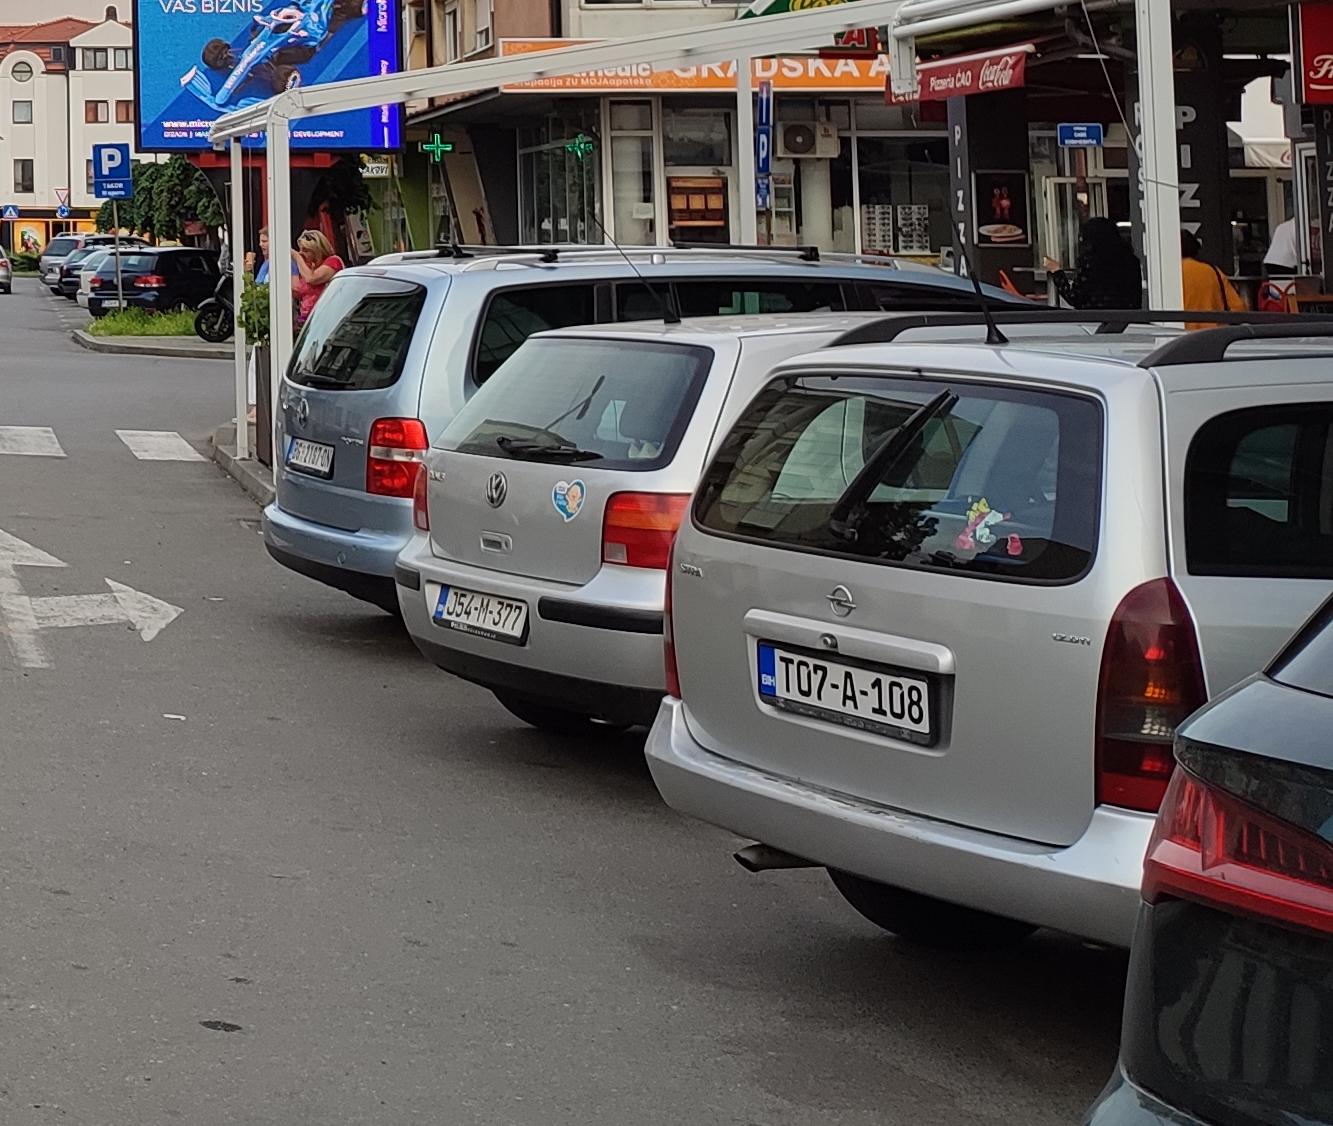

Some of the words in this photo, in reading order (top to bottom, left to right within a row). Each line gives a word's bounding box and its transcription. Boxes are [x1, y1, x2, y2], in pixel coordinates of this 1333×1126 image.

[581, 78, 652, 87] MOJAapoteka
[100, 148, 122, 176] P
[953, 125, 968, 276] PIZZA
[446, 591, 523, 632] J54-M-377
[779, 655, 924, 725] T07-A-108
